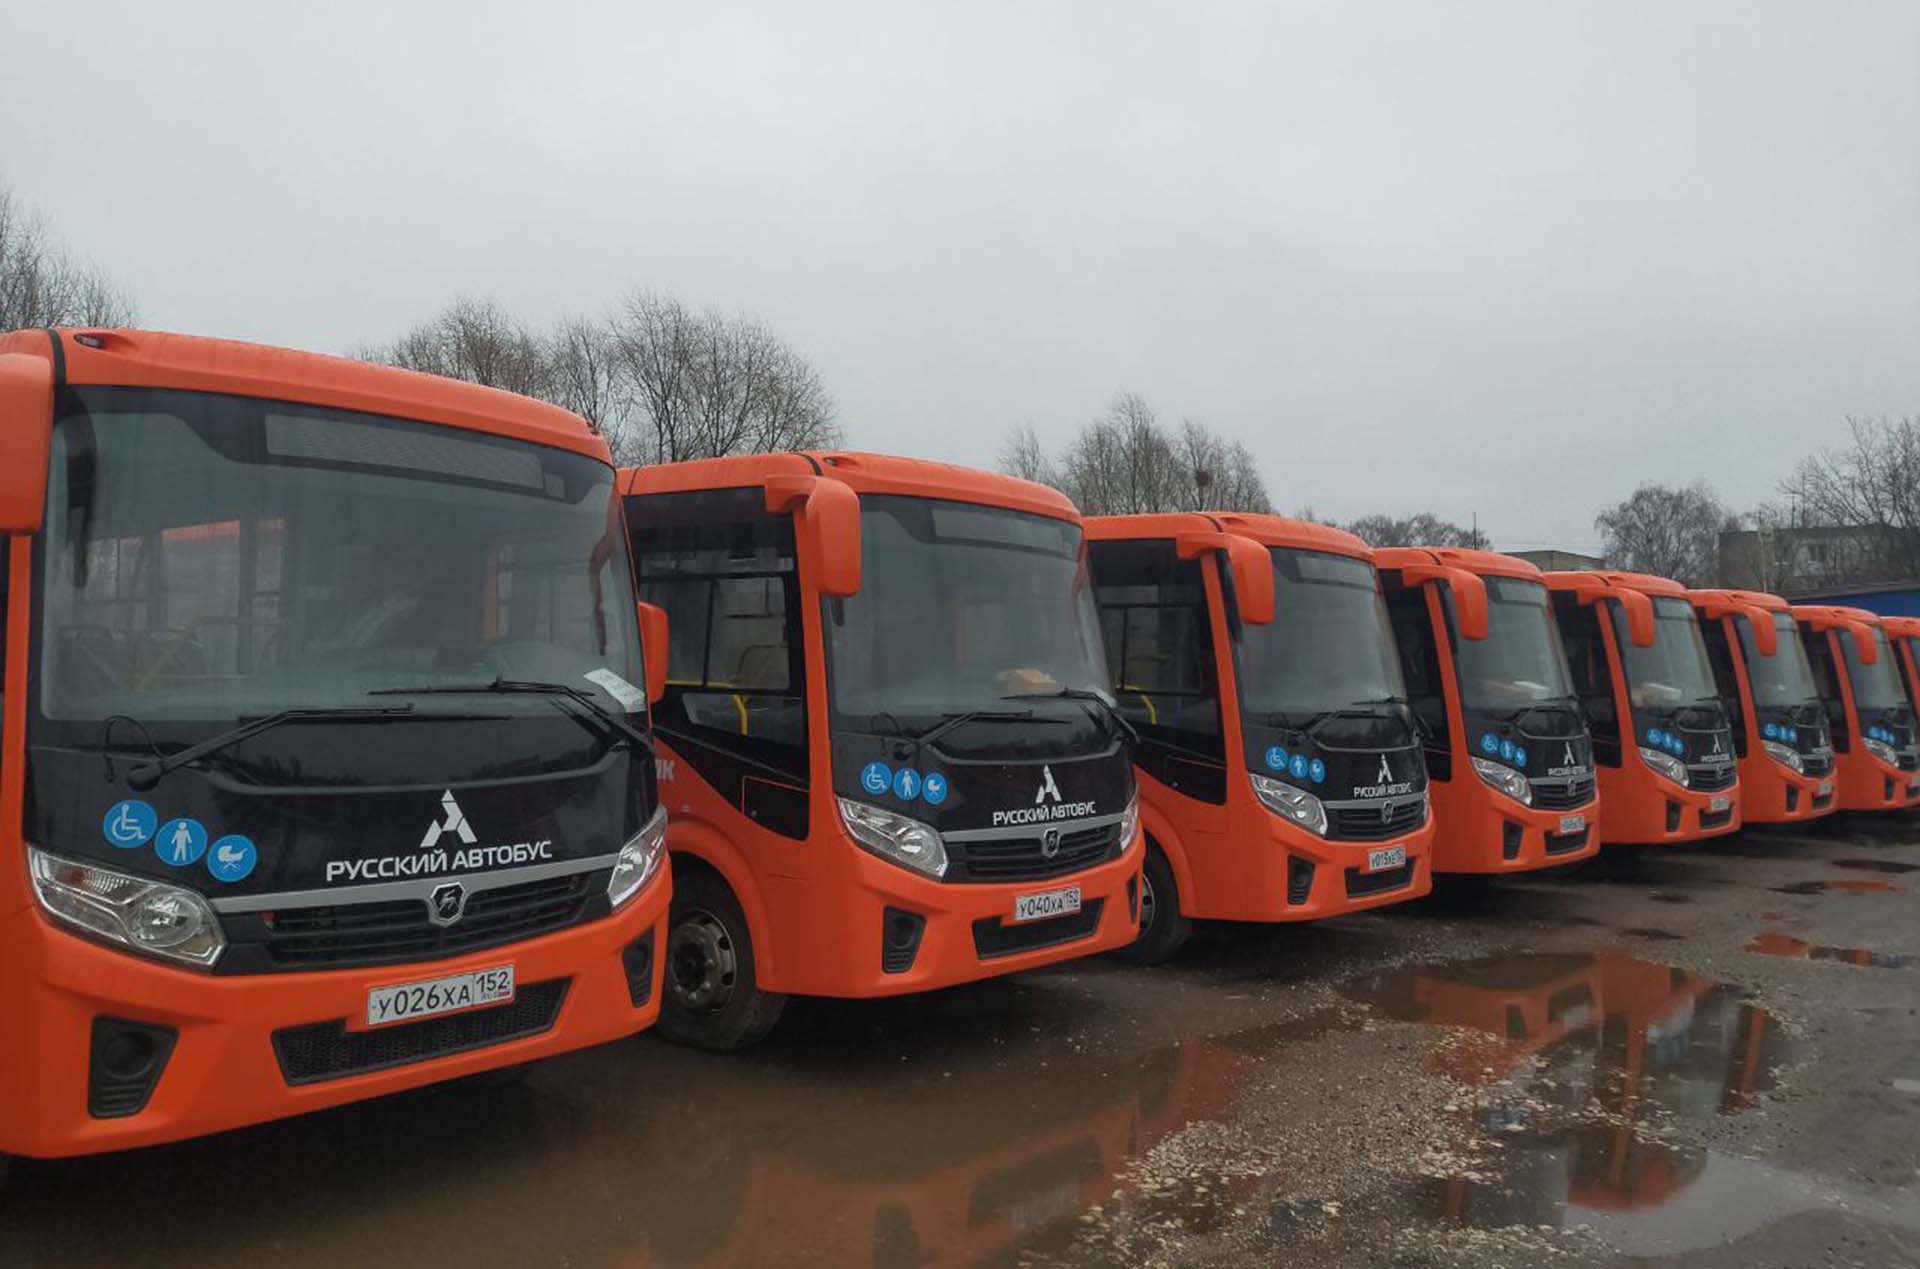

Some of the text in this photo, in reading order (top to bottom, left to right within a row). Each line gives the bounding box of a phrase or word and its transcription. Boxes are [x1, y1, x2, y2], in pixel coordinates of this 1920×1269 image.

[993, 801, 1096, 826] РУССКИЙ АВТОБУС
[326, 840, 553, 882] РУССКИЙ АВТОБУС
[379, 971, 508, 1019] У026ХА 152
